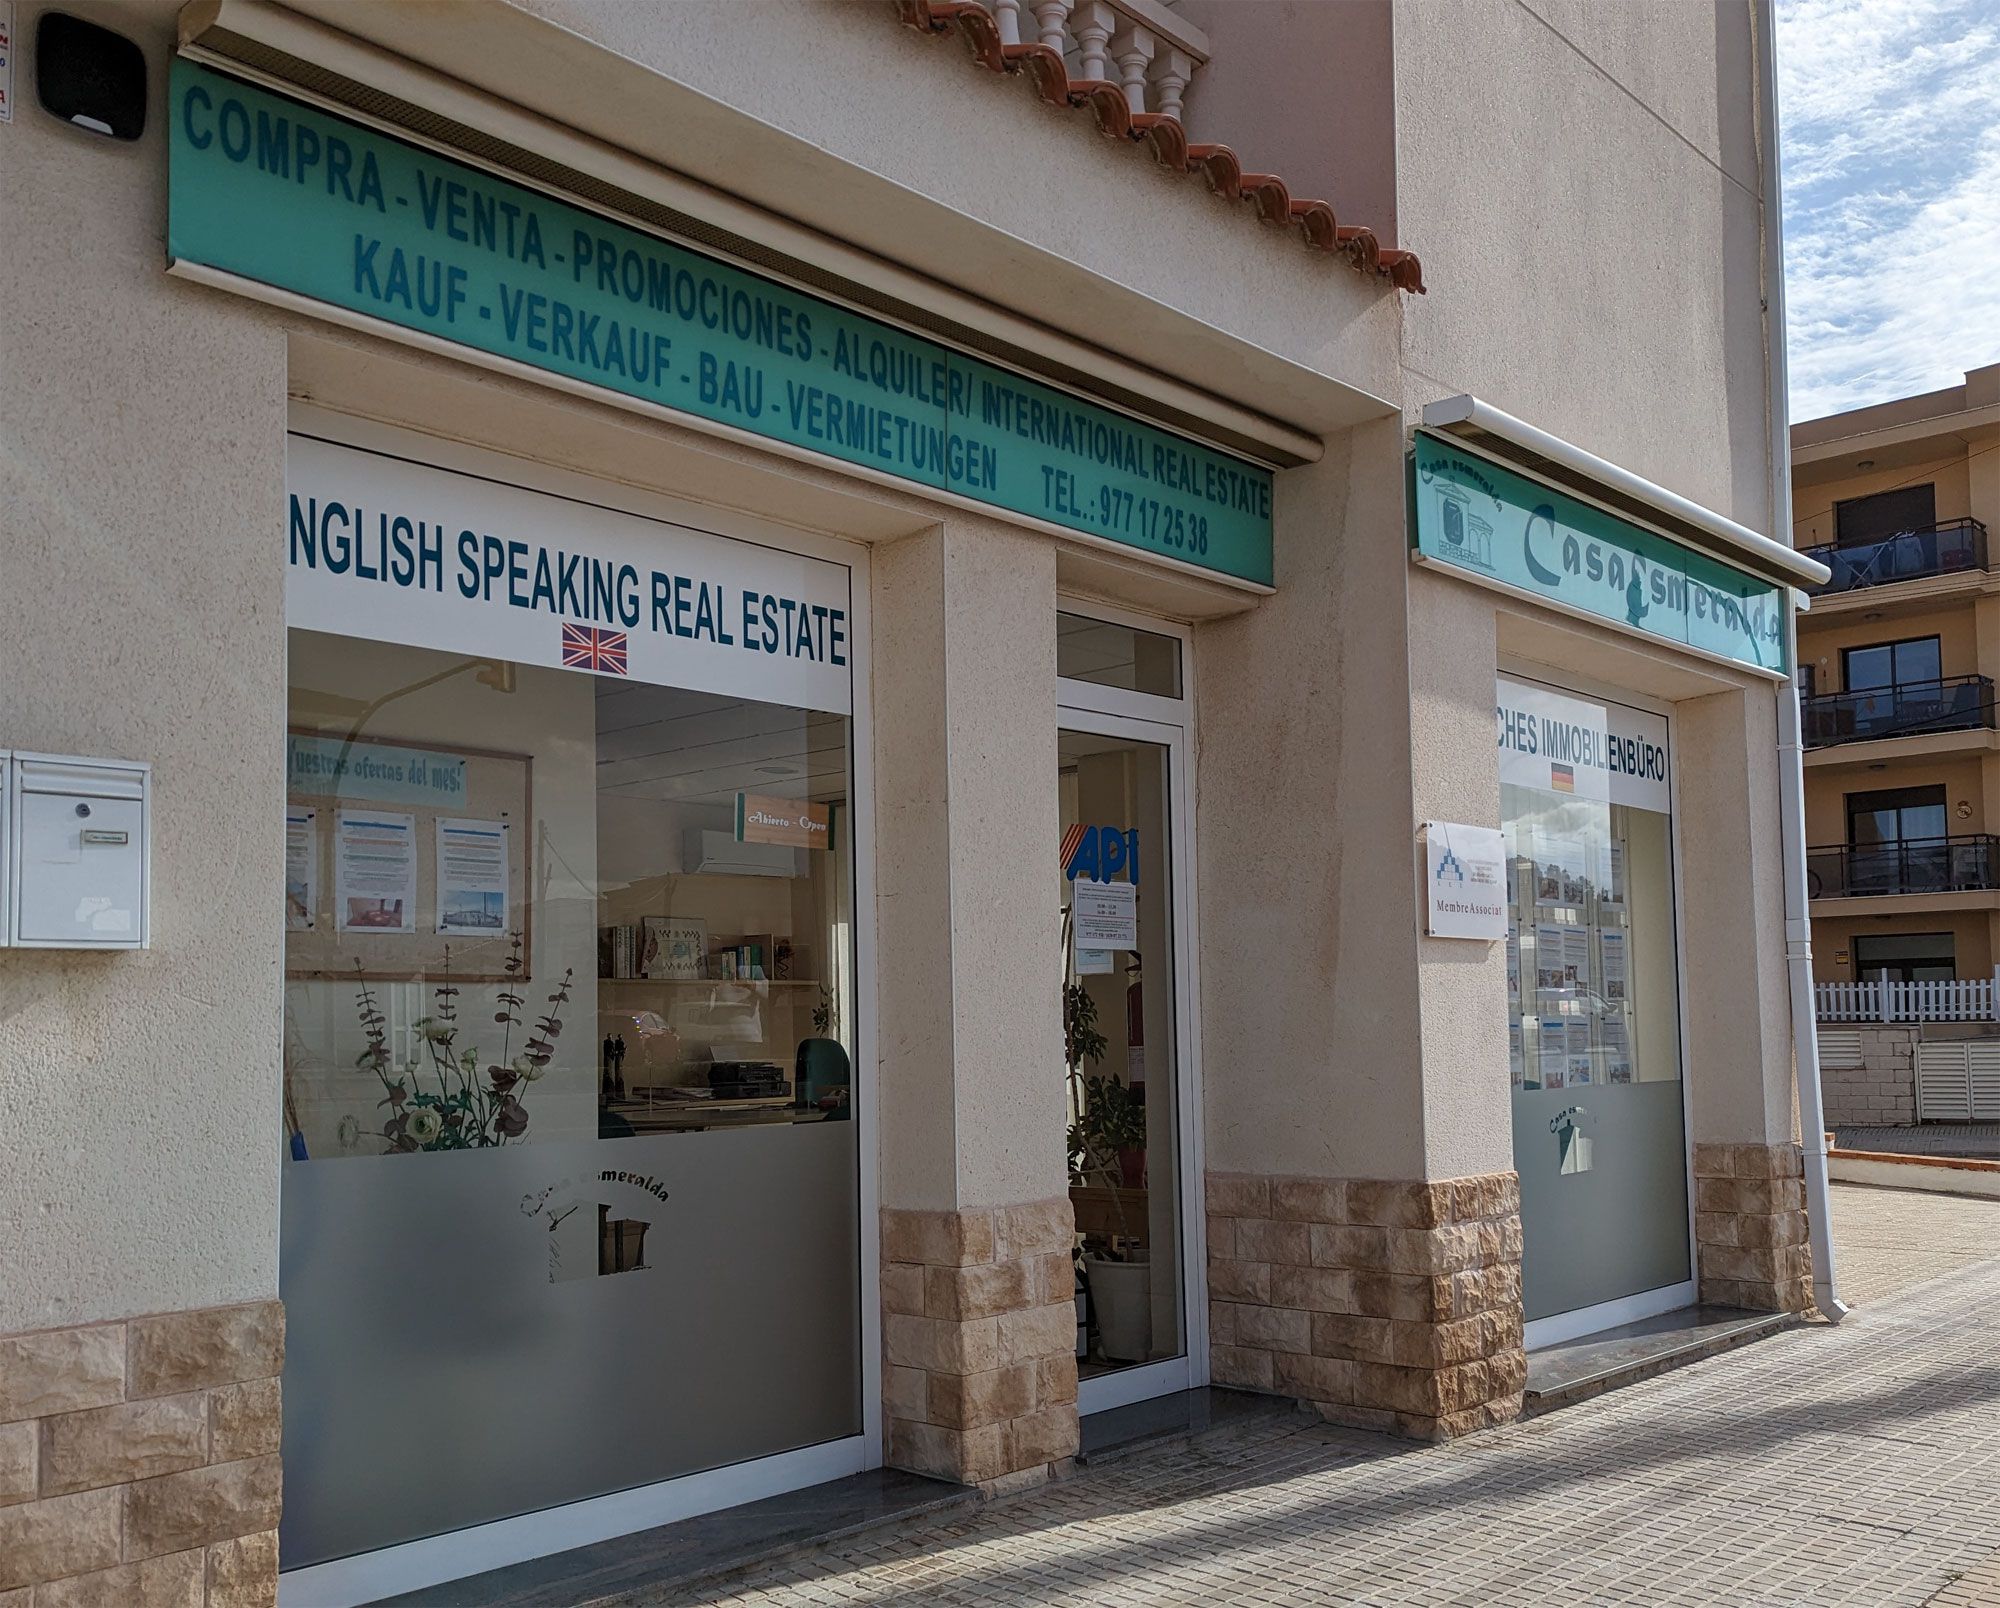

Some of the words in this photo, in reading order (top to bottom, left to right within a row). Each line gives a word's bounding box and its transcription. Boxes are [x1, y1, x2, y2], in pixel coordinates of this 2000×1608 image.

[184, 86, 386, 213] COMPRA
[417, 168, 546, 271] VENTA
[573, 230, 812, 362] PROMOCIONES
[982, 380, 1150, 479] INTERNATIONAL
[1153, 443, 1203, 497] REAL
[1206, 462, 1270, 520] ESTATE
[354, 234, 467, 323] KAUF
[500, 283, 671, 387] VERKAUF
[700, 351, 763, 419] BAU
[787, 380, 997, 491] VERMIETUNGEN
[1524, 503, 1625, 592] Casa
[457, 530, 640, 628] SPEAKING
[651, 571, 734, 647] REAL
[742, 590, 846, 667] ESTATE
[354, 756, 403, 782] ofertas
[408, 758, 427, 786] del
[1542, 718, 1665, 782] IMMOBILIENBÜRO
[597, 1169, 669, 1202] meralda
